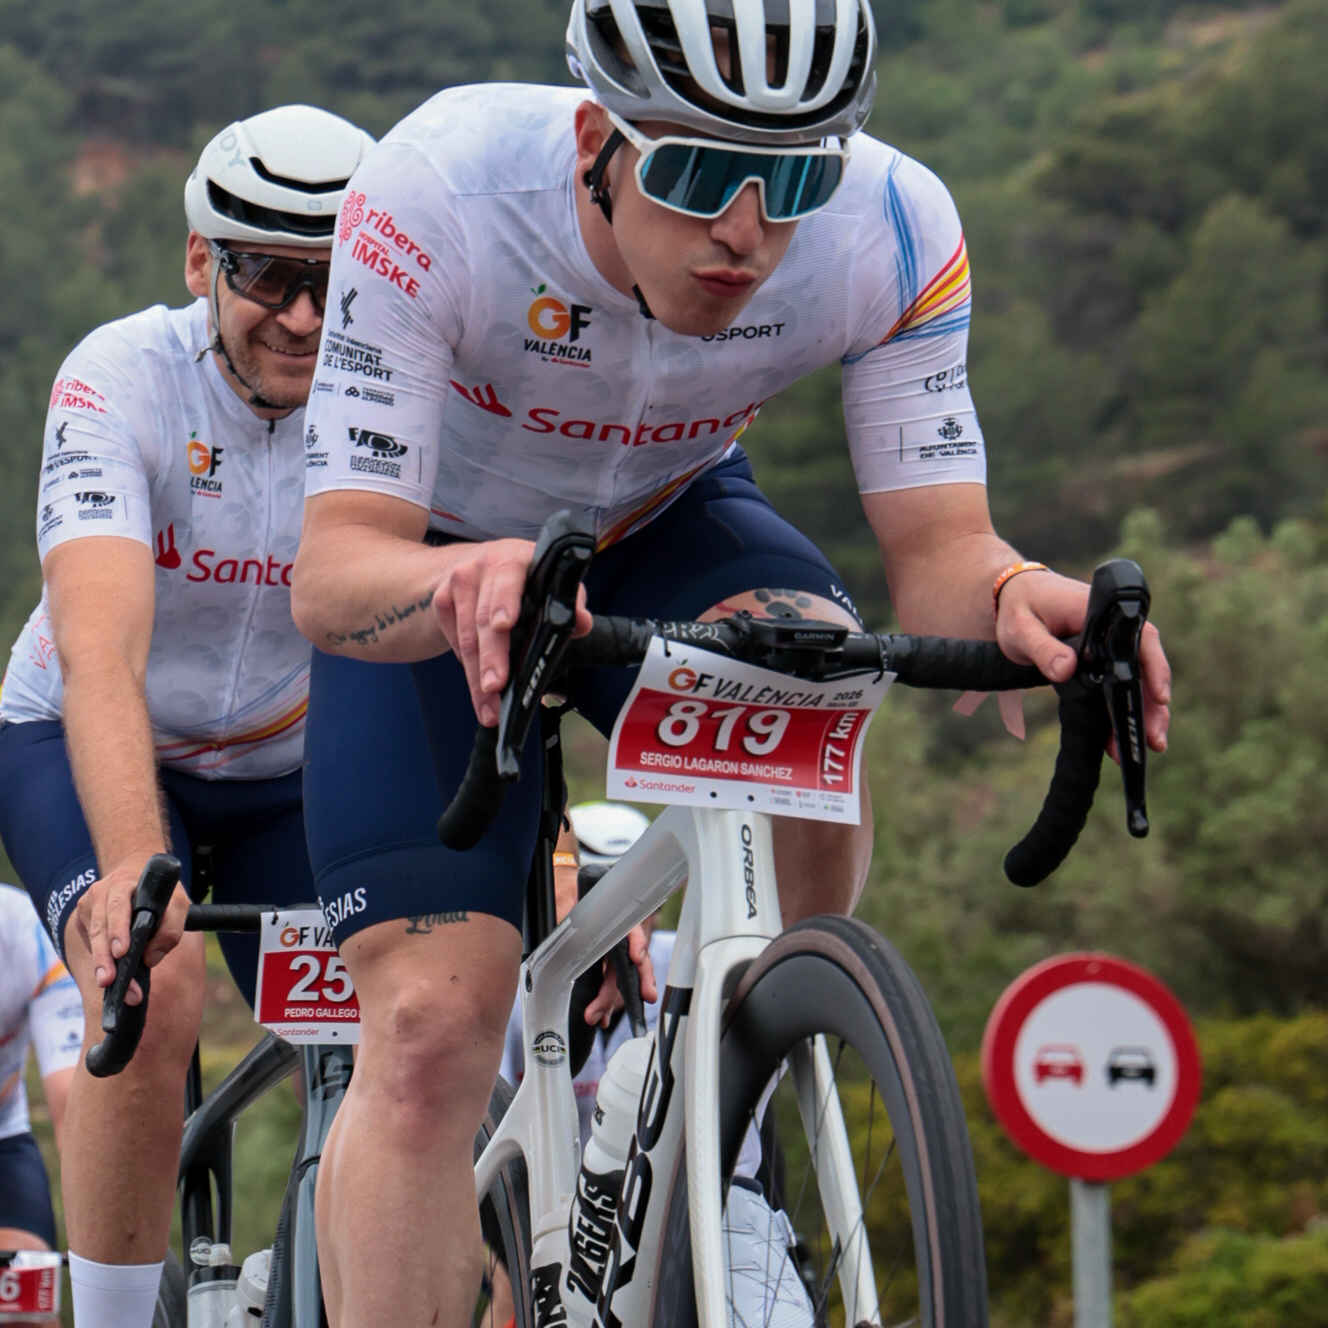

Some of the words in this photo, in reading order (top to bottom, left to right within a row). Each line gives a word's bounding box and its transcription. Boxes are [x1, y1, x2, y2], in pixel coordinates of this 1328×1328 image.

[358, 230, 390, 257] HOSPITAL
[365, 209, 432, 272] ribera
[351, 239, 421, 298] IMSKE
[527, 296, 593, 343] GF
[324, 339, 383, 367] COMUNITAT
[524, 337, 592, 363] VALÈNCIA
[323, 354, 333, 368] DE
[334, 355, 394, 382] L'ESPORT
[522, 401, 766, 447] Santand
[187, 441, 224, 478] GF
[190, 476, 223, 493] LÈNCIA
[794, 632, 835, 641] GARMIN
[668, 667, 715, 694] GF
[714, 678, 825, 708] VALÈNCIA
[833, 690, 863, 700] 2026
[657, 700, 792, 756] 819
[828, 712, 859, 740] km
[640, 751, 683, 769] SERGIO
[684, 756, 739, 774] LAGARON
[740, 763, 793, 781] SANCHEZ
[823, 744, 845, 784] 177
[639, 779, 695, 794] Santander
[741, 823, 758, 920] ORBEA
[279, 926, 311, 948] GF
[284, 1008, 314, 1018] PEDRO
[315, 1008, 357, 1018] GALLEGO
[277, 1027, 320, 1037] Santander
[541, 1044, 560, 1053] UCI
